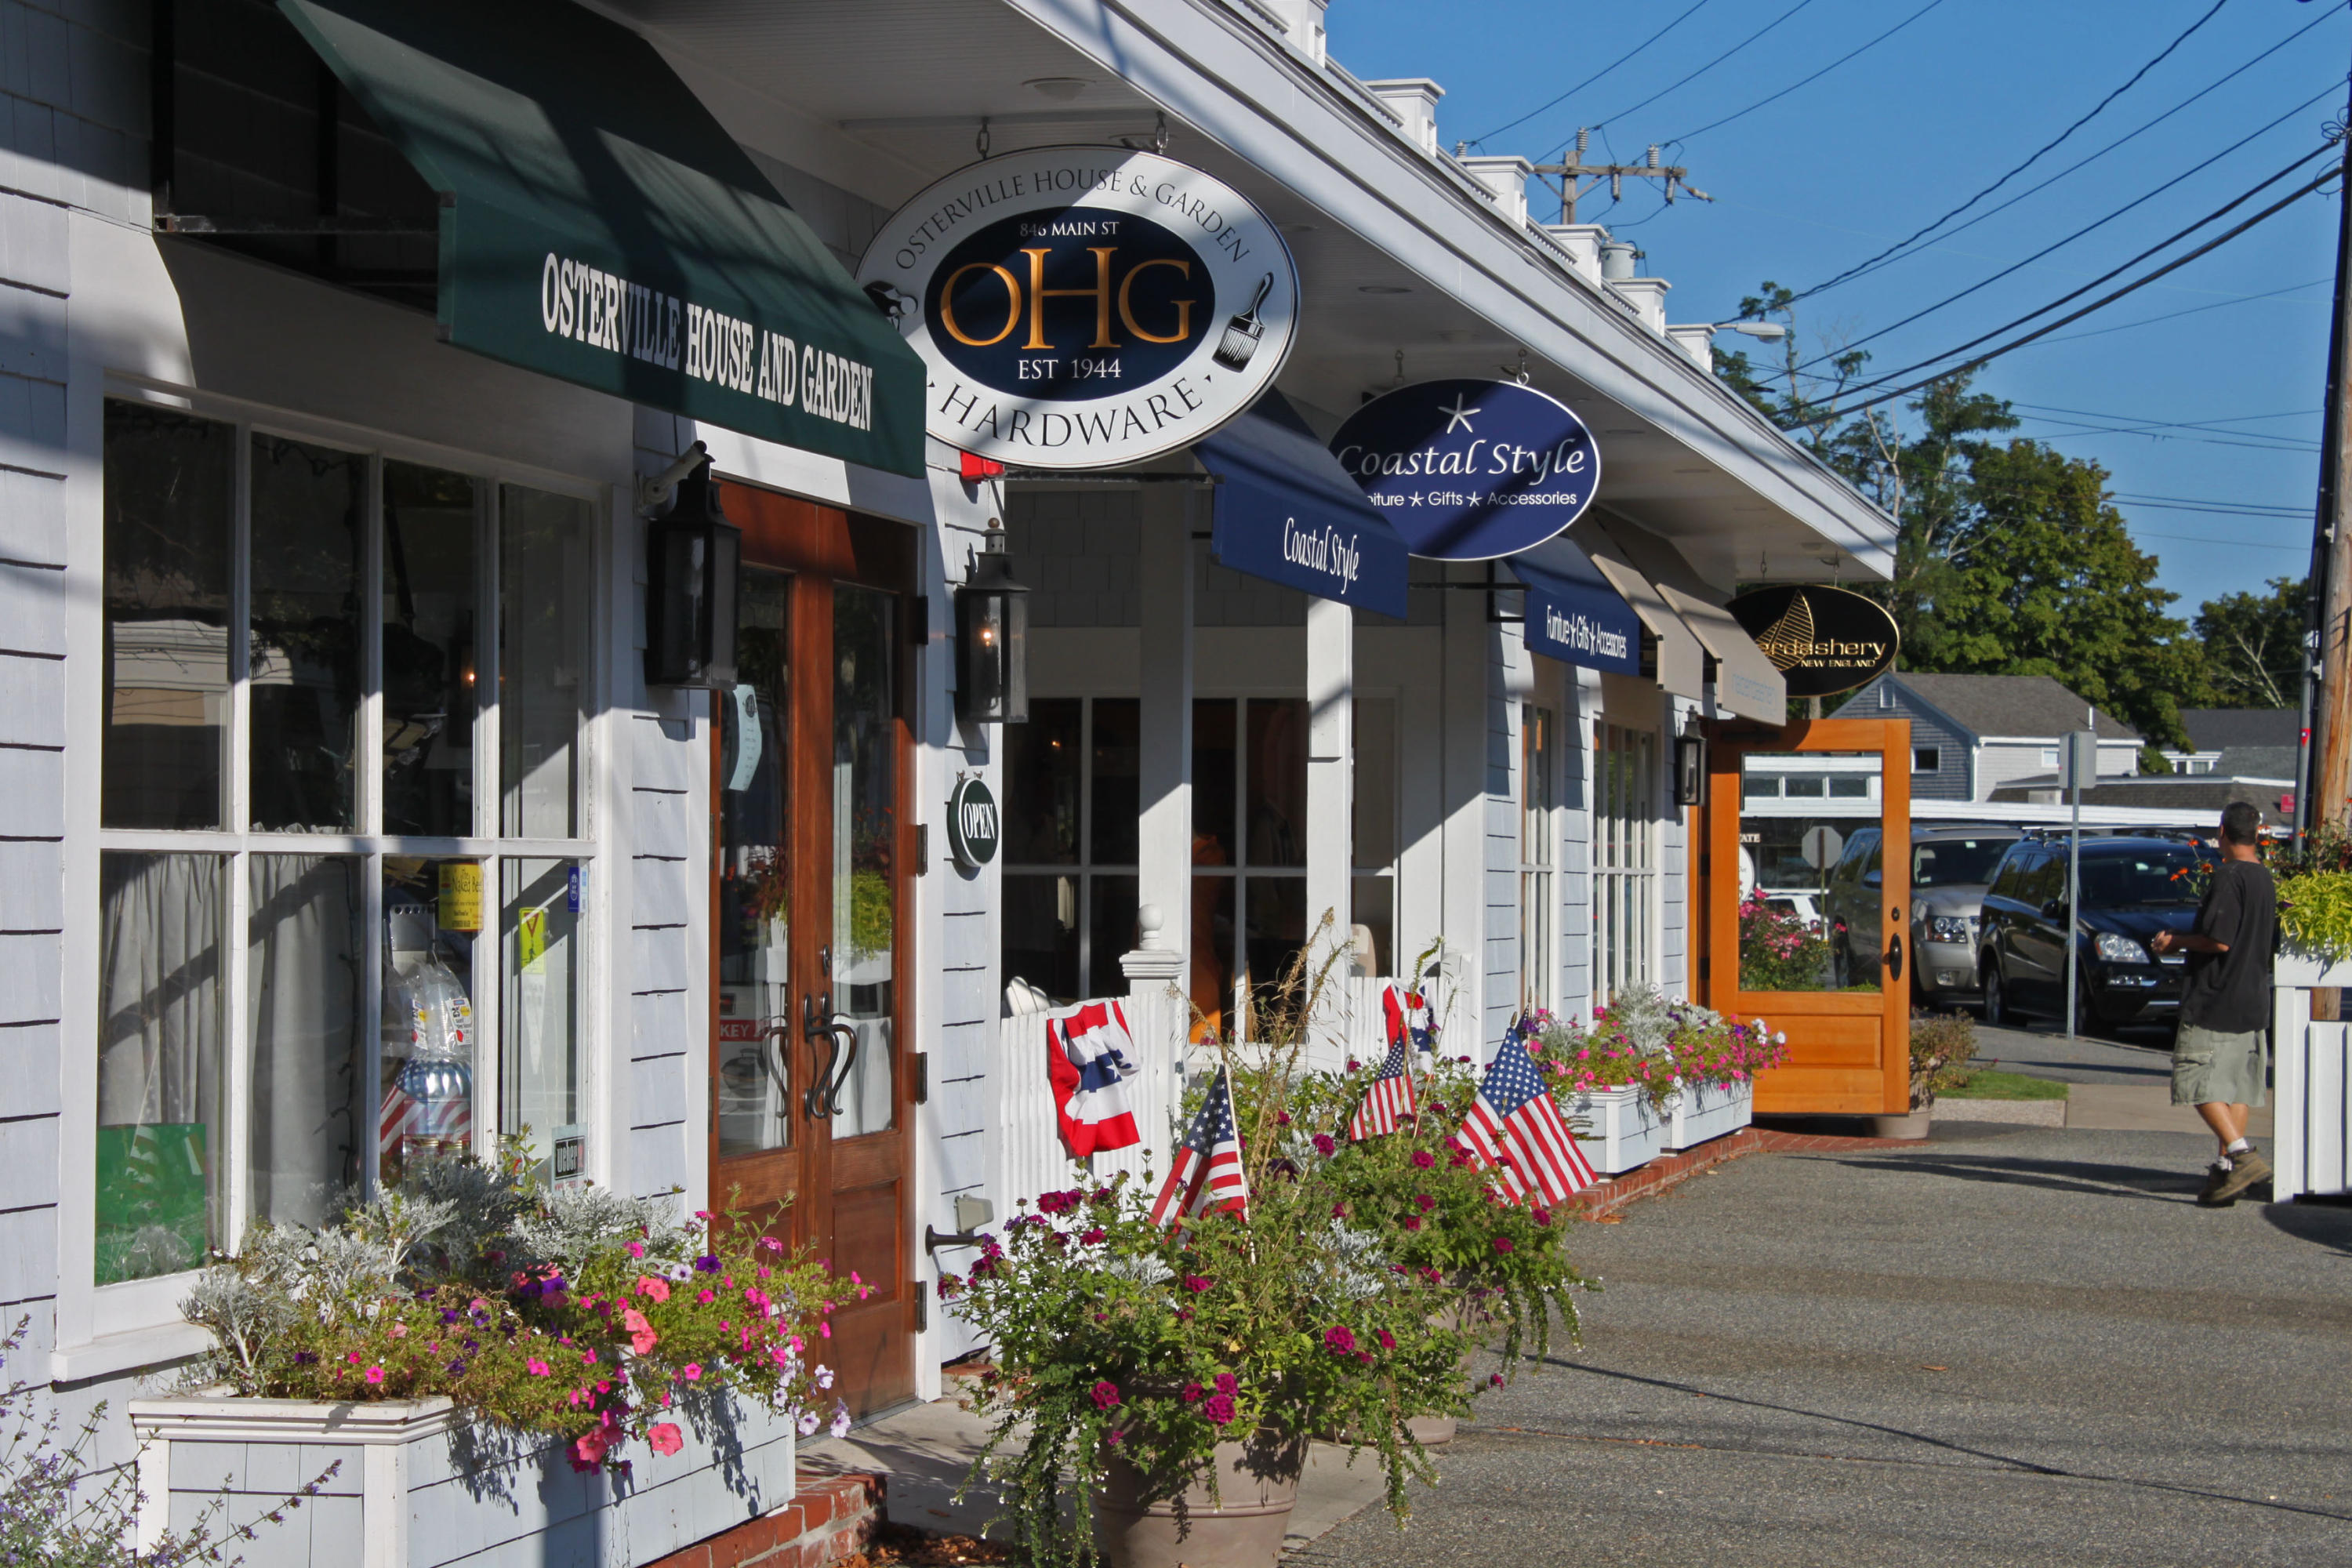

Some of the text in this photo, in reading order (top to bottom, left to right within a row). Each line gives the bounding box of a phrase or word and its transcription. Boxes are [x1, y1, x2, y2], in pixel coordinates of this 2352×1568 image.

[895, 168, 1250, 270] OSTERVILLE HOUSE & GARDEN
[1019, 221, 1120, 238] 846 MAIN ST
[940, 245, 1196, 350] OHG
[542, 252, 873, 432] OSTERVILLE HOUSE AND GARDEN
[1018, 358, 1122, 380] EST 1944
[938, 376, 1203, 448] HARDWARE
[1337, 437, 1585, 486] Coastal Style
[1428, 490, 1464, 506] Gifts
[1486, 490, 1577, 506] Accessories
[1283, 517, 1360, 595] Coastal Style
[1546, 604, 1627, 659] Furniture Gifts Accessories
[1801, 659, 1877, 668] NEW ENGLAND
[964, 802, 995, 840] OPEN
[1739, 833, 1762, 844] ATE
[720, 1023, 750, 1038] KEY
